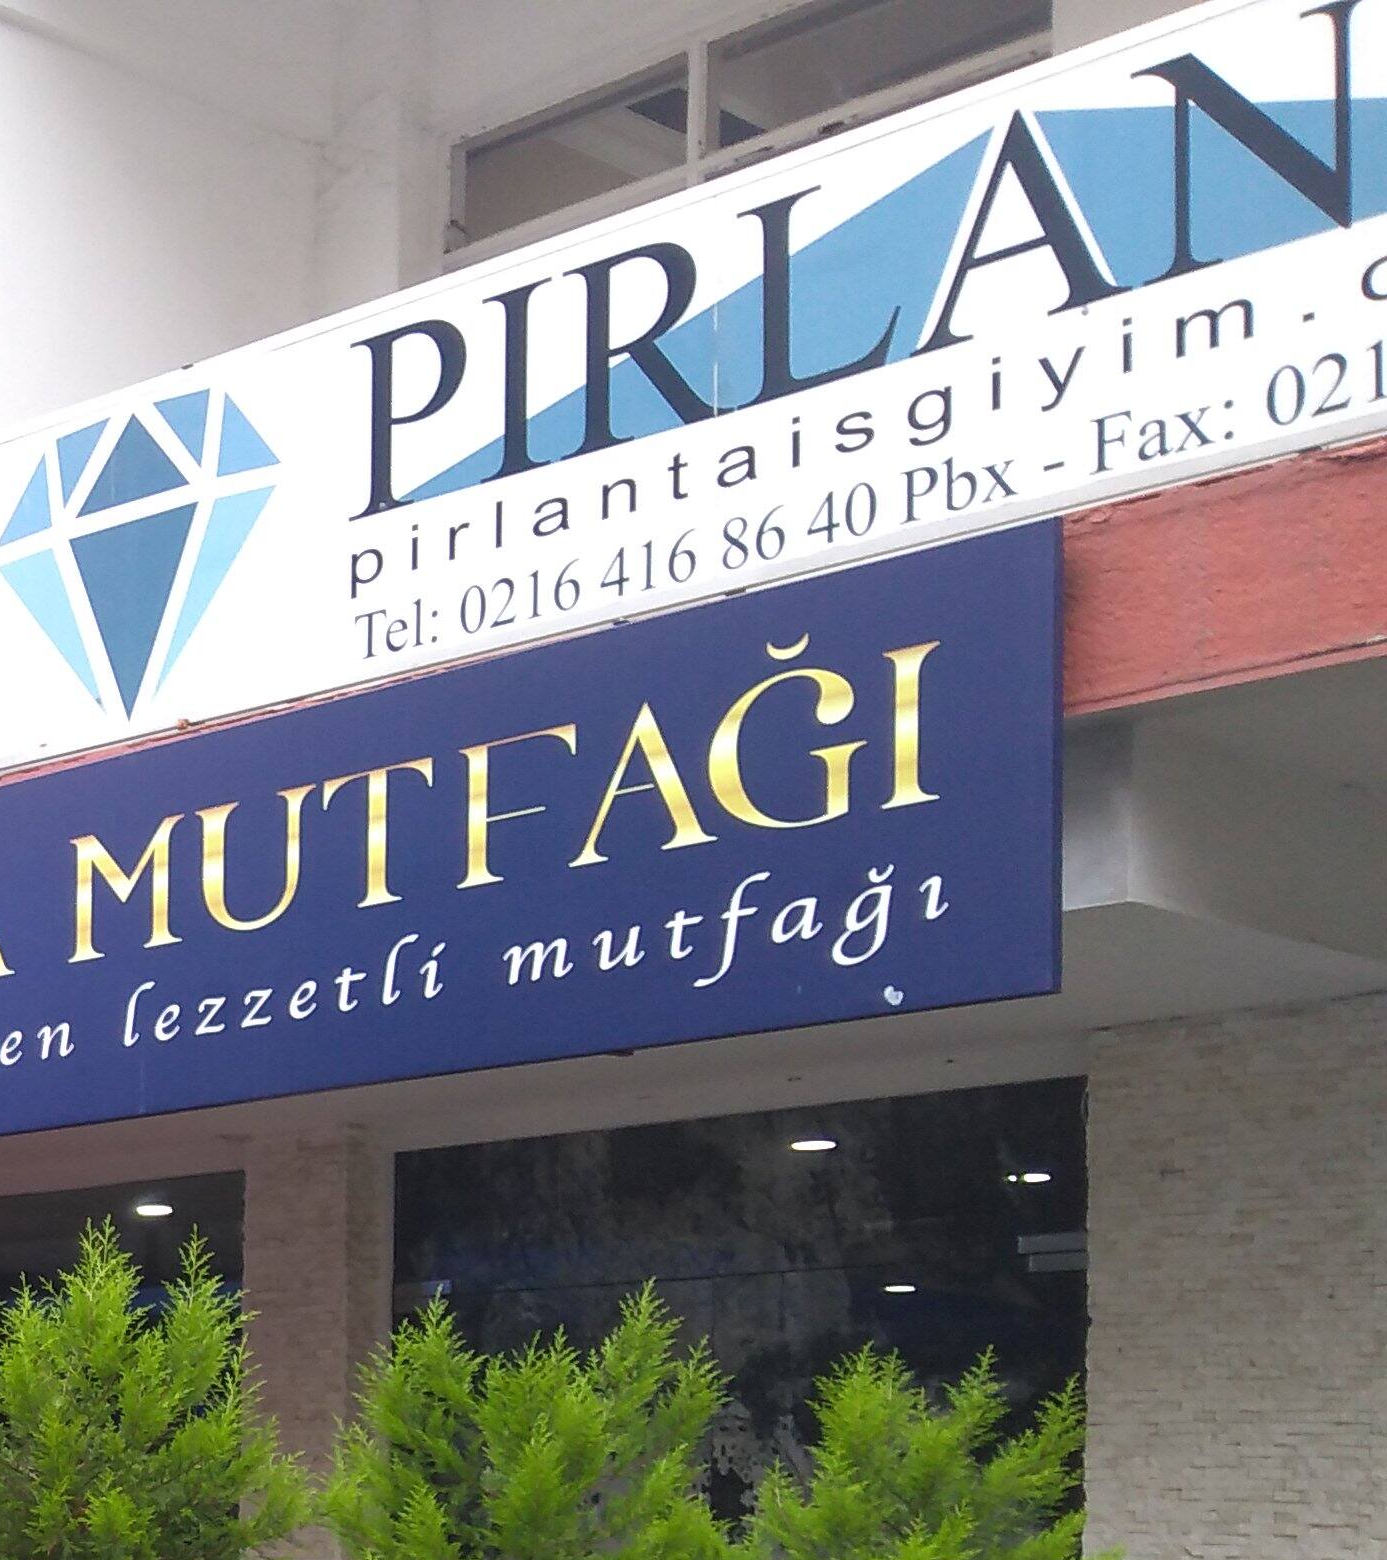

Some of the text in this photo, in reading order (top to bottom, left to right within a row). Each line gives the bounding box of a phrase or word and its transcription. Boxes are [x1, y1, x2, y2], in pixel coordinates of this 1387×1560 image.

[349, 0, 1364, 522] PIRLAN
[355, 598, 439, 660] Tel:
[459, 557, 581, 634] 0216
[600, 527, 698, 597] 416
[721, 503, 786, 571] 86
[806, 481, 878, 545] 40
[899, 457, 1019, 525] Pbx
[1089, 398, 1235, 477] Fax:
[1265, 338, 1387, 428] 021
[67, 632, 941, 965] MUTFAĞI
[122, 933, 448, 1045] lezzetli
[504, 861, 950, 989] mutfağı
